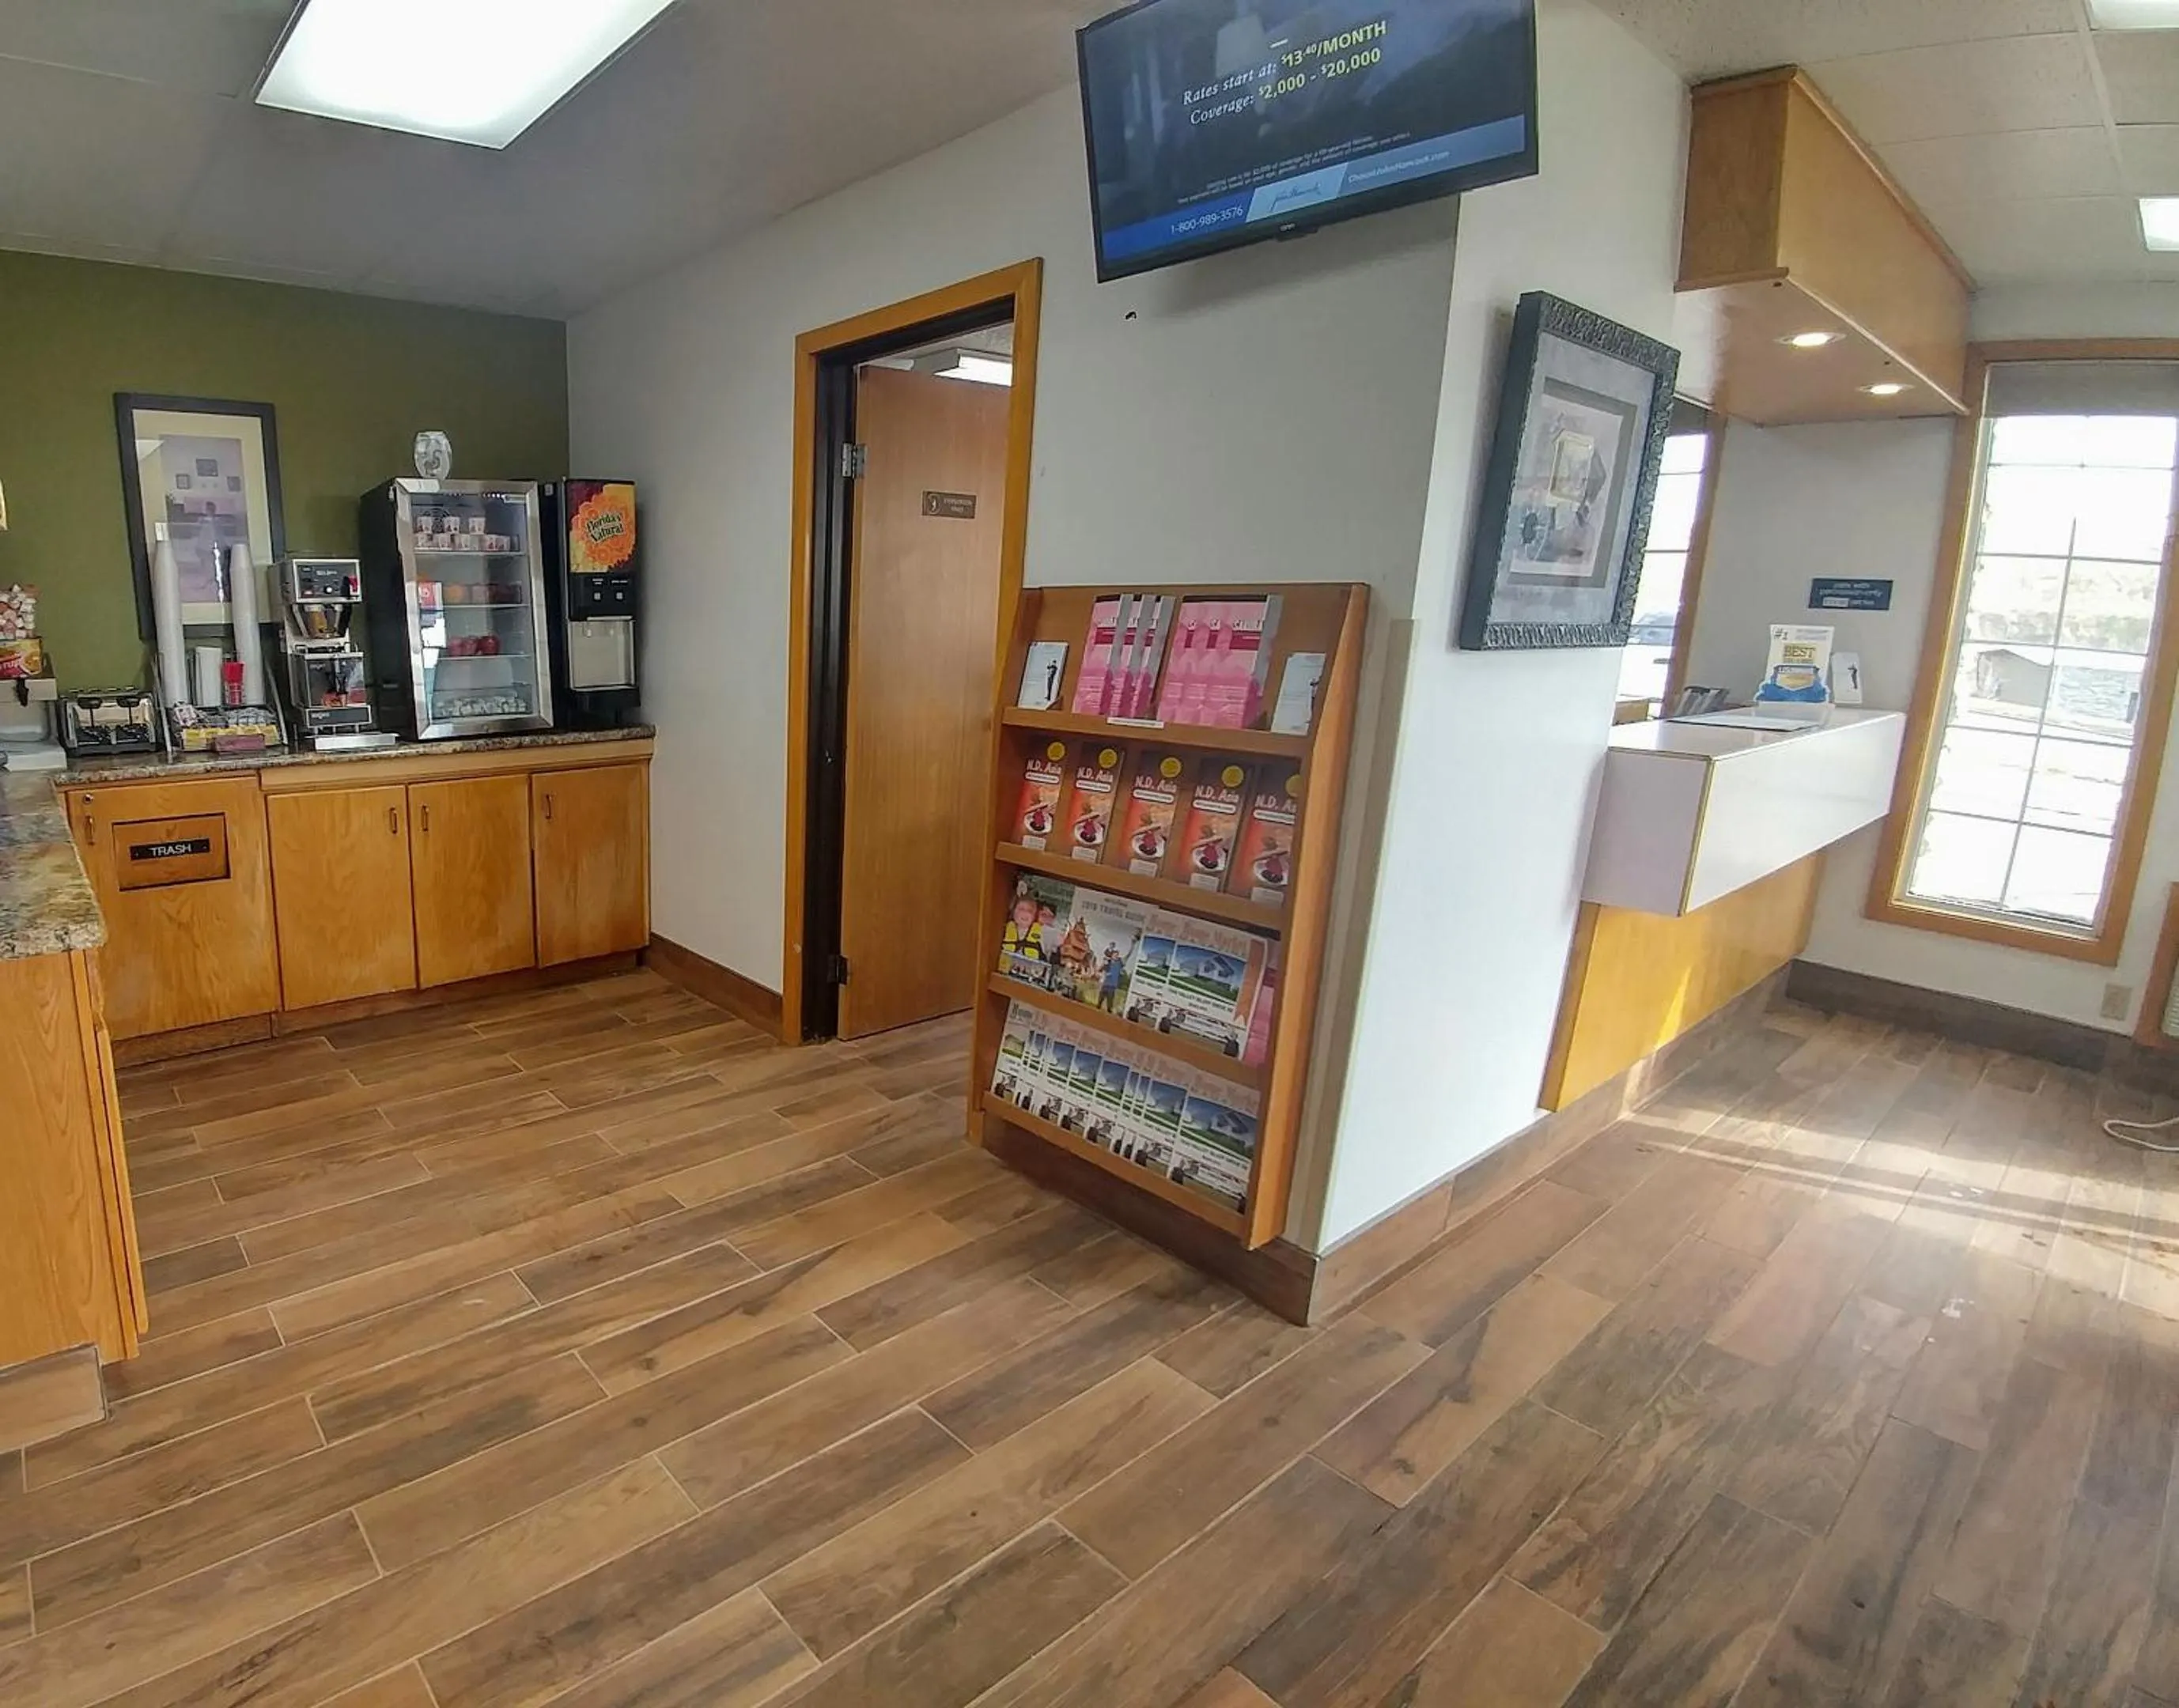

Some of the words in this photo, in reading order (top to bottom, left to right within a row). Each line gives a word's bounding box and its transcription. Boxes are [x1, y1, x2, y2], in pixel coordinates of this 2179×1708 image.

[1182, 83, 1218, 105] Rates
[1223, 69, 1254, 91] start
[1258, 62, 1277, 77] at:
[1190, 94, 1254, 125] Coverage:
[1258, 73, 1305, 100] $2,000
[1321, 47, 1381, 78] $20,000
[1170, 206, 1244, 235] 1-800-989-3576
[1784, 644, 1817, 658] BEST
[149, 843, 191, 856] TRASH
